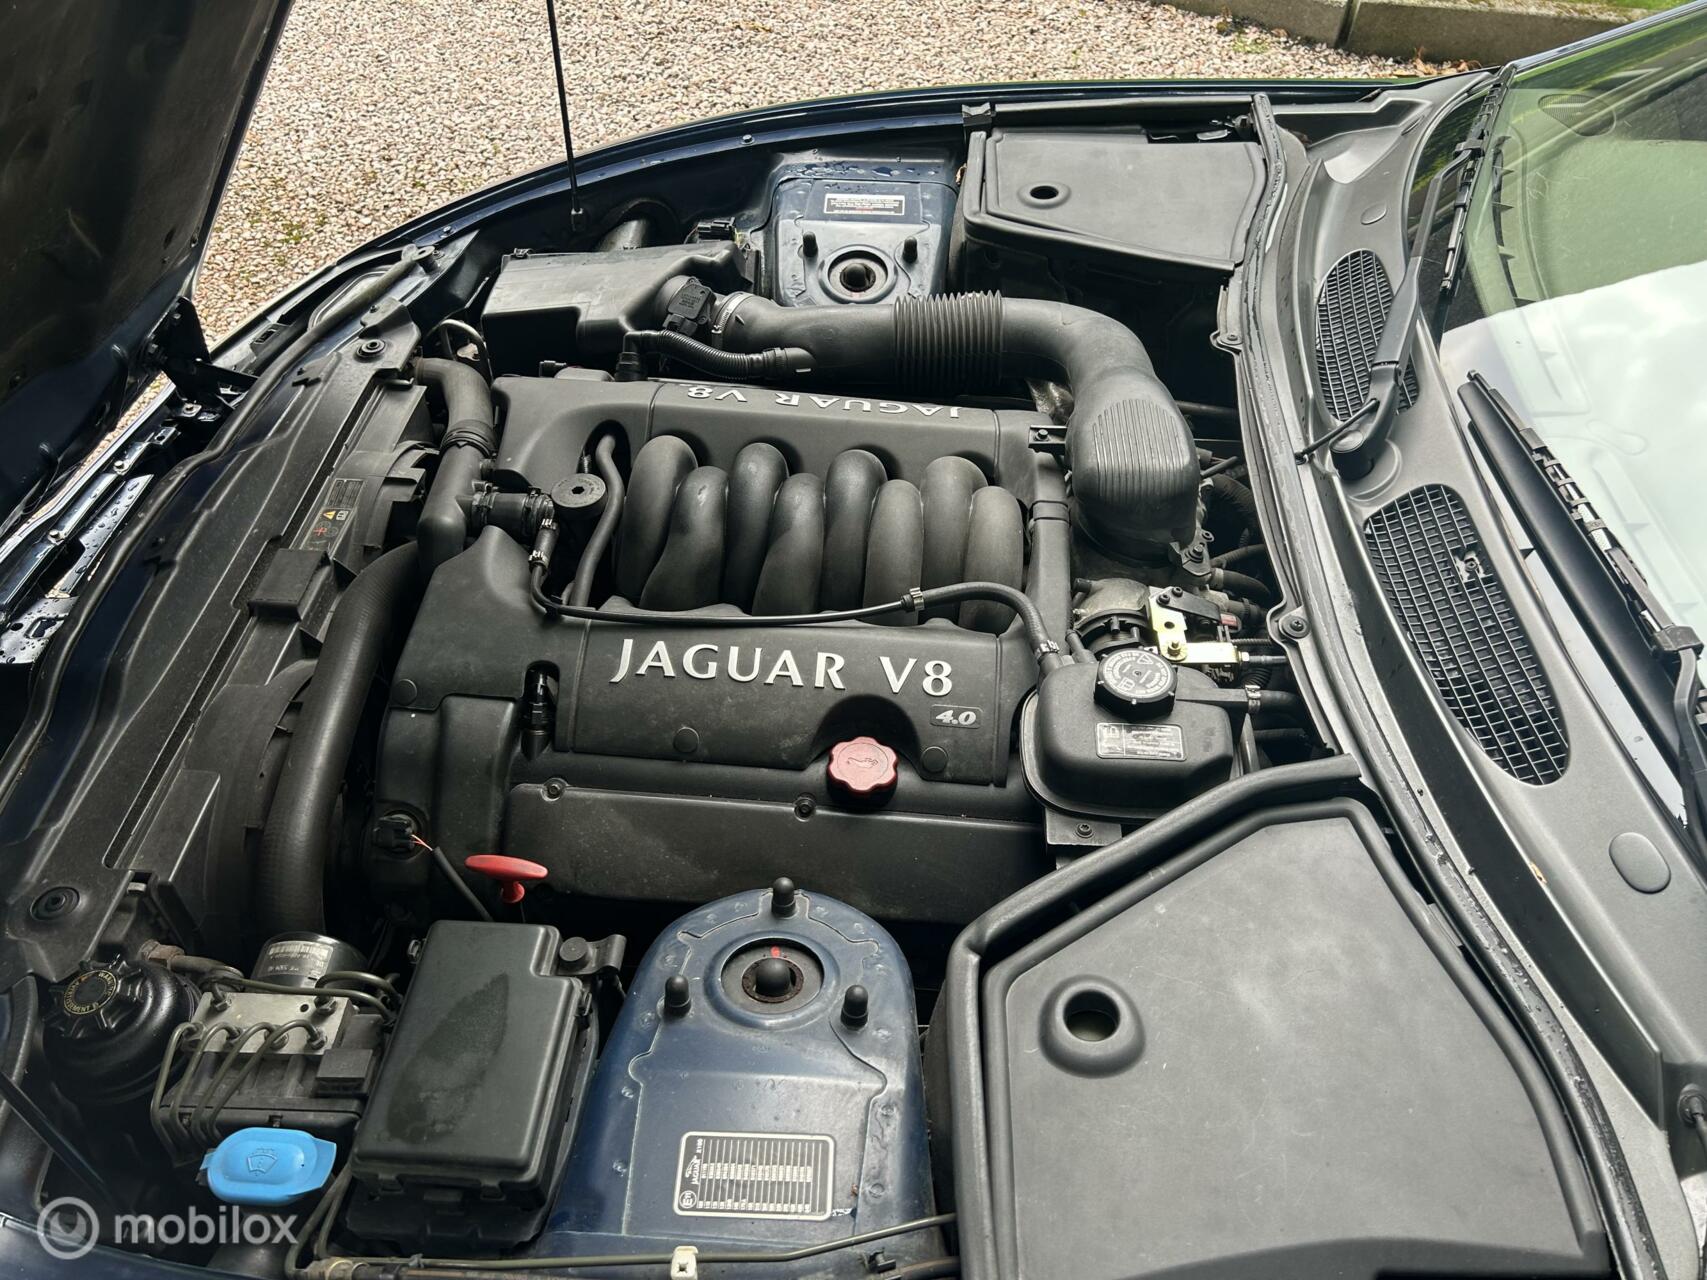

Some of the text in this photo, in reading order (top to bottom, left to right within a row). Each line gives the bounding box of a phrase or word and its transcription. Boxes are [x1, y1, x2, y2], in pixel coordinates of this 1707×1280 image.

[687, 386, 962, 418] JAGUAR V8
[609, 638, 954, 697] JAGUAR V8
[935, 709, 977, 725] 4.0
